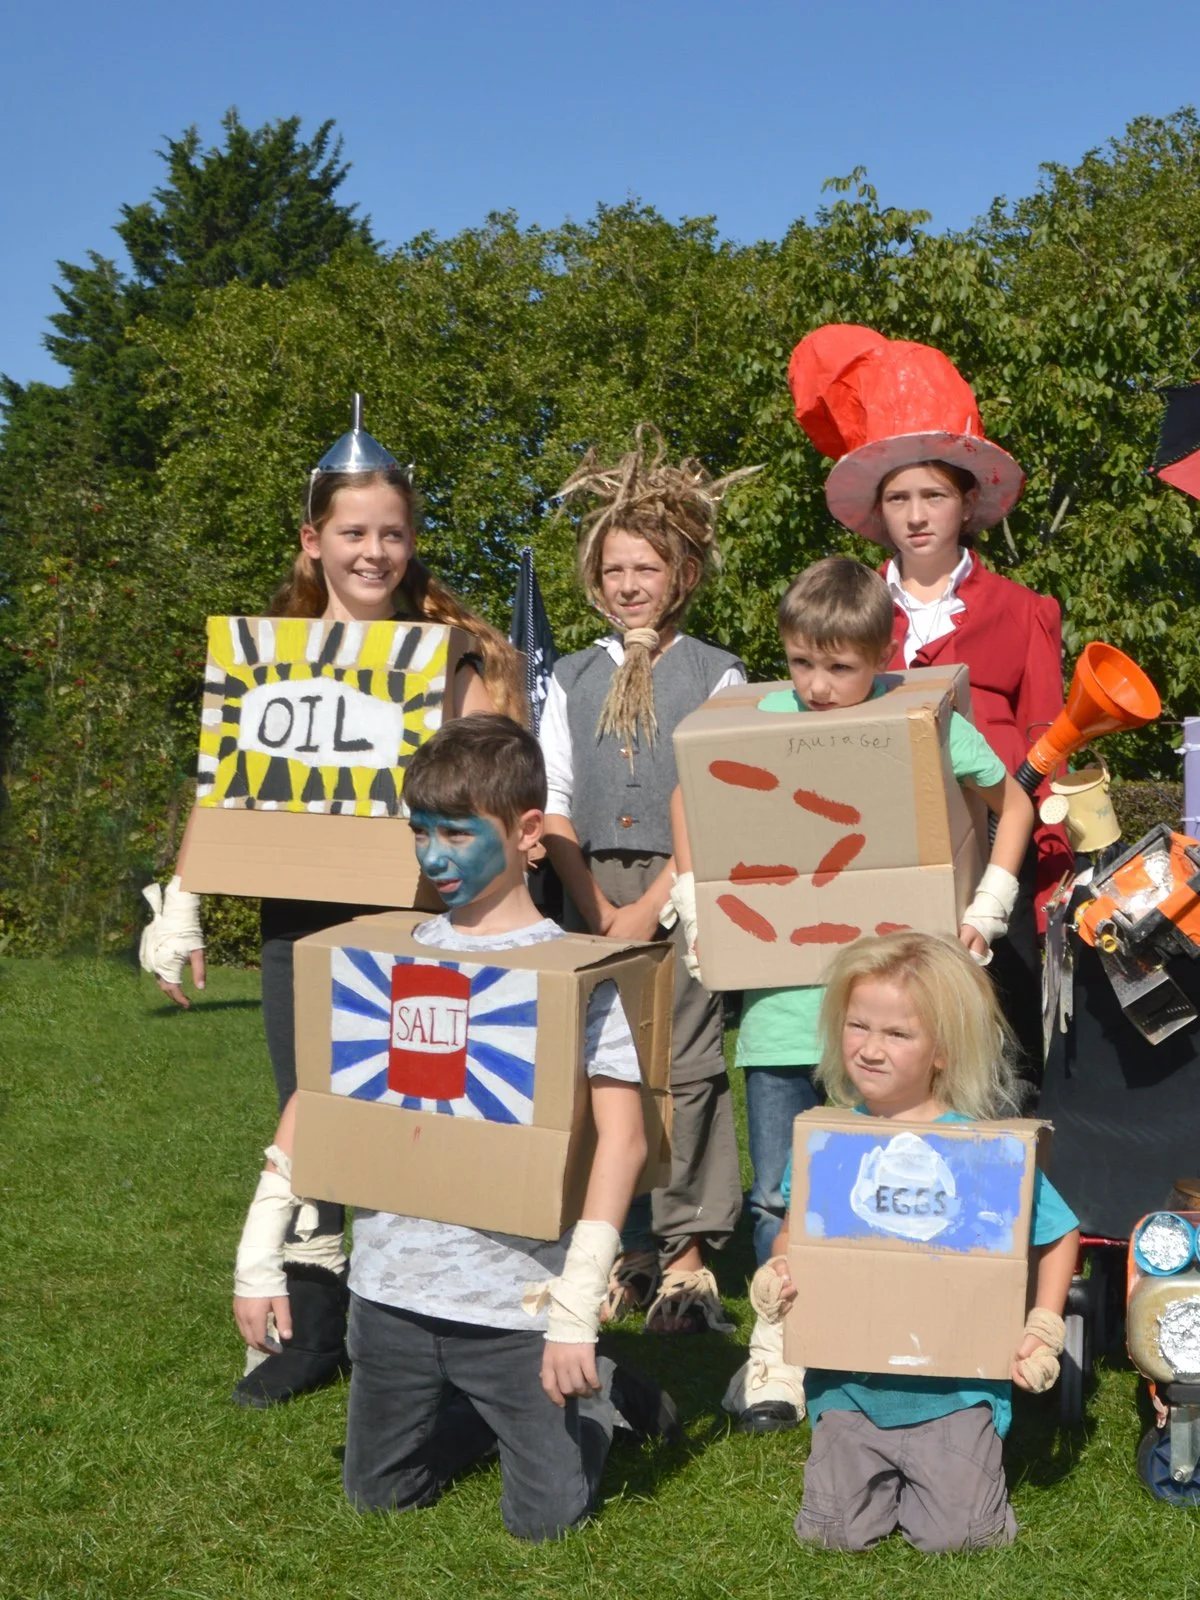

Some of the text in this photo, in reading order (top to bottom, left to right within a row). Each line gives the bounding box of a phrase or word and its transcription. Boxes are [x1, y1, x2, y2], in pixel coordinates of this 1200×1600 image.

[257, 695, 374, 752] OIL
[396, 1006, 466, 1046] SALT
[875, 1185, 948, 1216] EGGS
